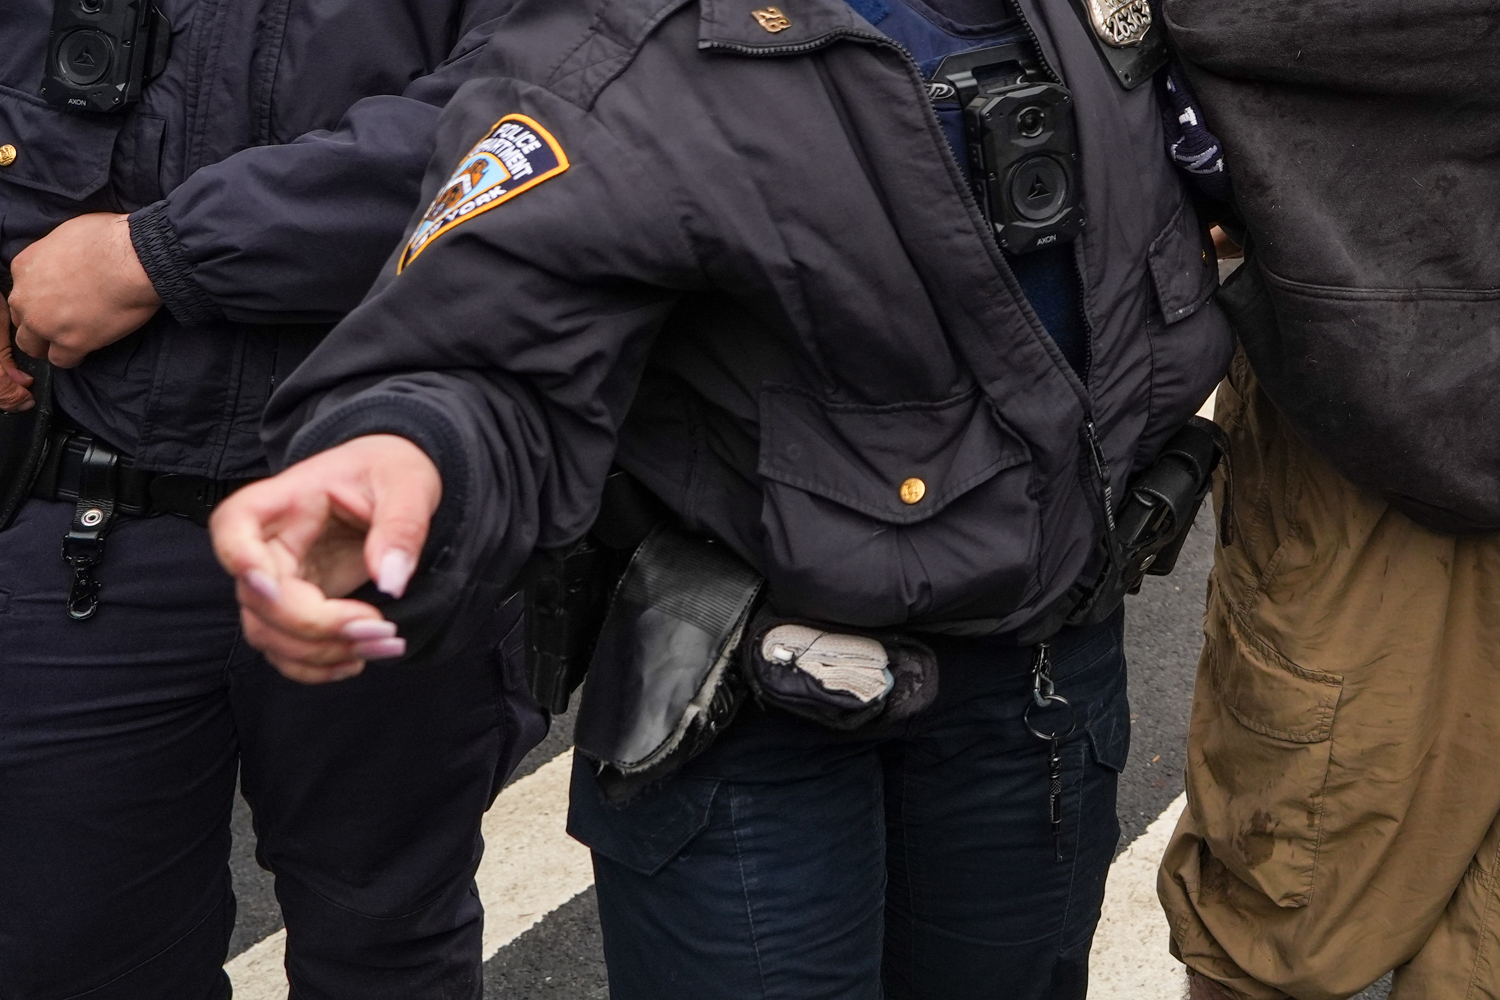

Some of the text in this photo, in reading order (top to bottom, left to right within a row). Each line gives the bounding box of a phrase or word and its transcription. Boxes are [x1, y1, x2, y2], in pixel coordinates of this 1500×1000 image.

[1106, 0, 1152, 43] 26363
[67, 98, 87, 106] AXON
[491, 122, 542, 155] POLICE
[445, 185, 508, 222] YORK
[1036, 234, 1057, 246] AXON
